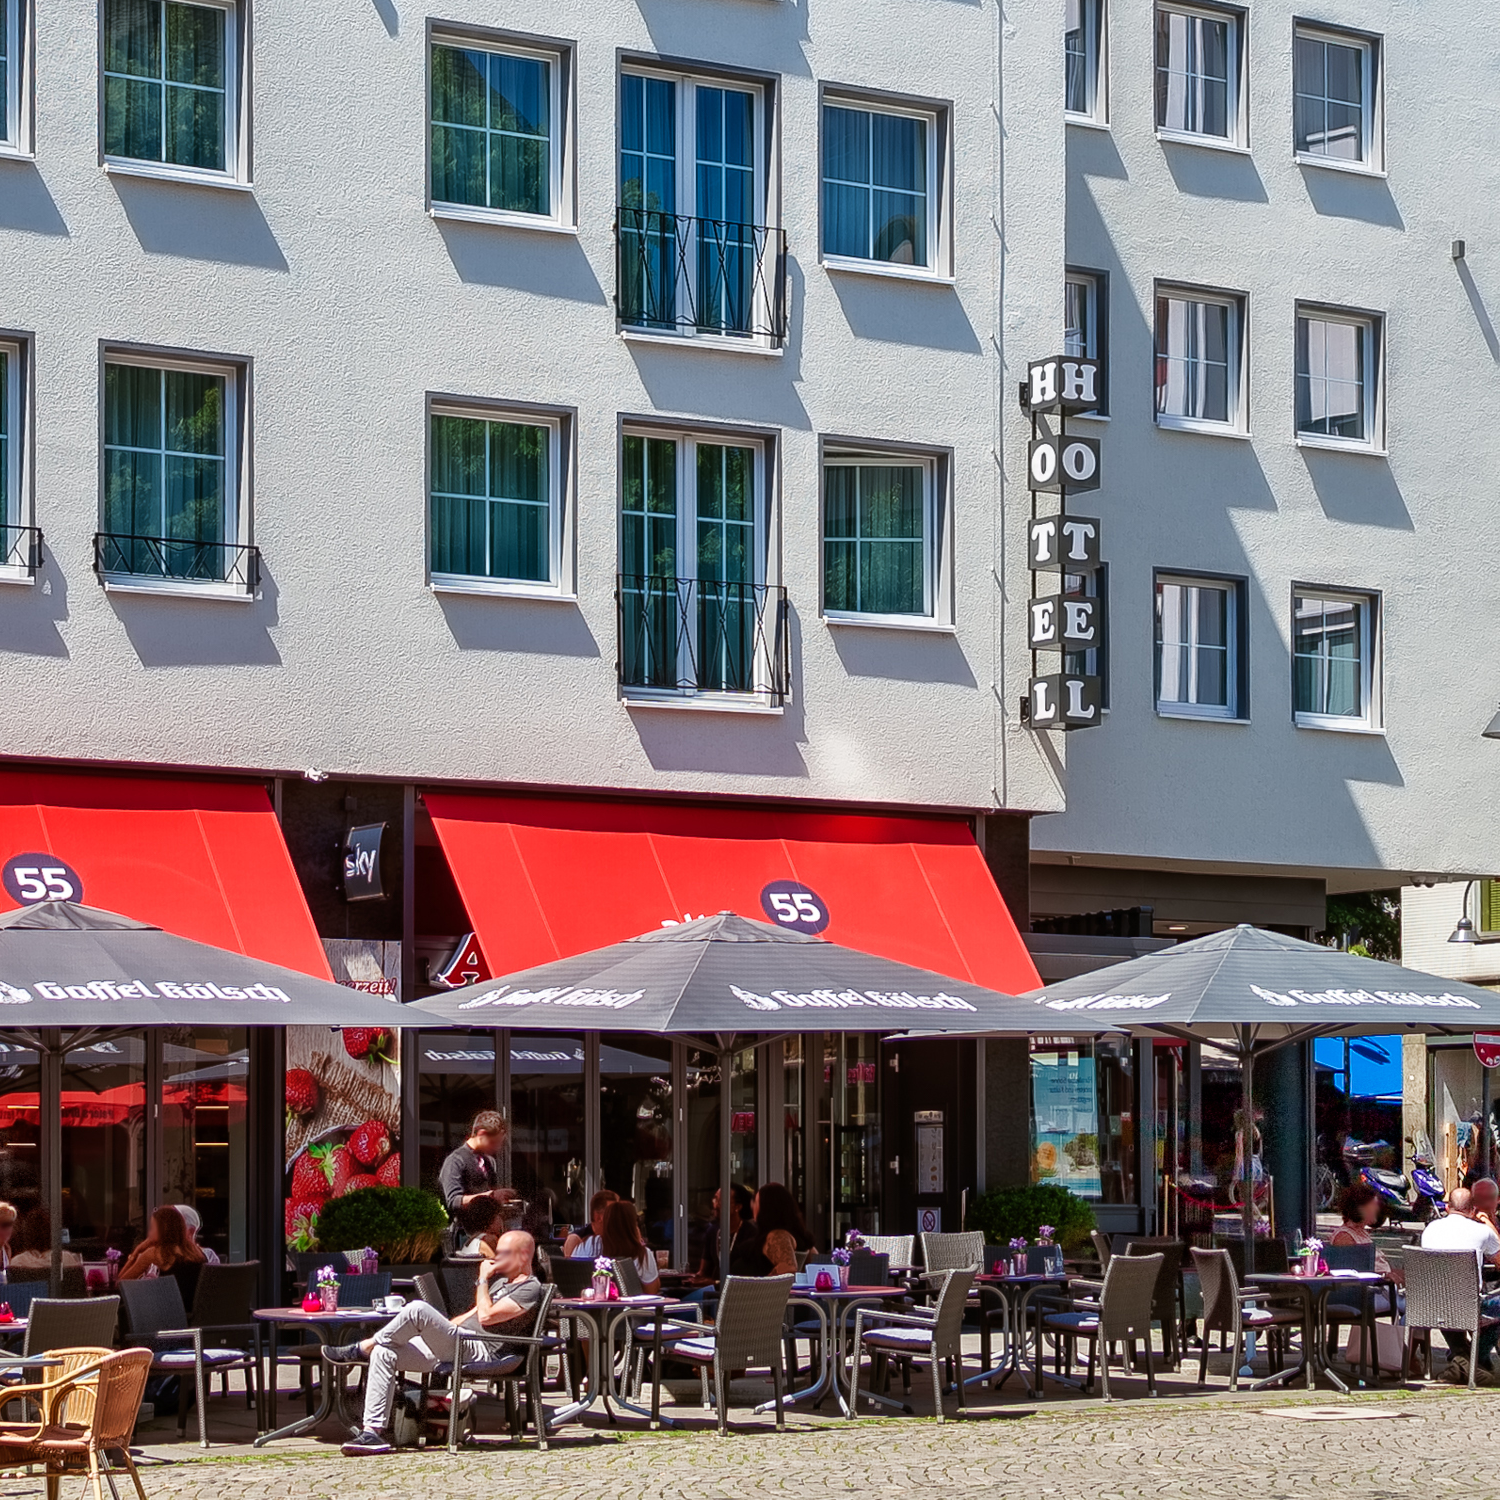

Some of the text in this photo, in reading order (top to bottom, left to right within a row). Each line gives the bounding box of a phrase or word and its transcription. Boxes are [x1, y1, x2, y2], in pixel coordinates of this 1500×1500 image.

[344, 842, 377, 884] sky
[13, 866, 75, 901] 55
[768, 892, 822, 923] 55
[32, 979, 292, 1003] Gaffel Kölsch
[770, 988, 877, 1009] Gaffel
[1288, 989, 1386, 1006] Gaffel
